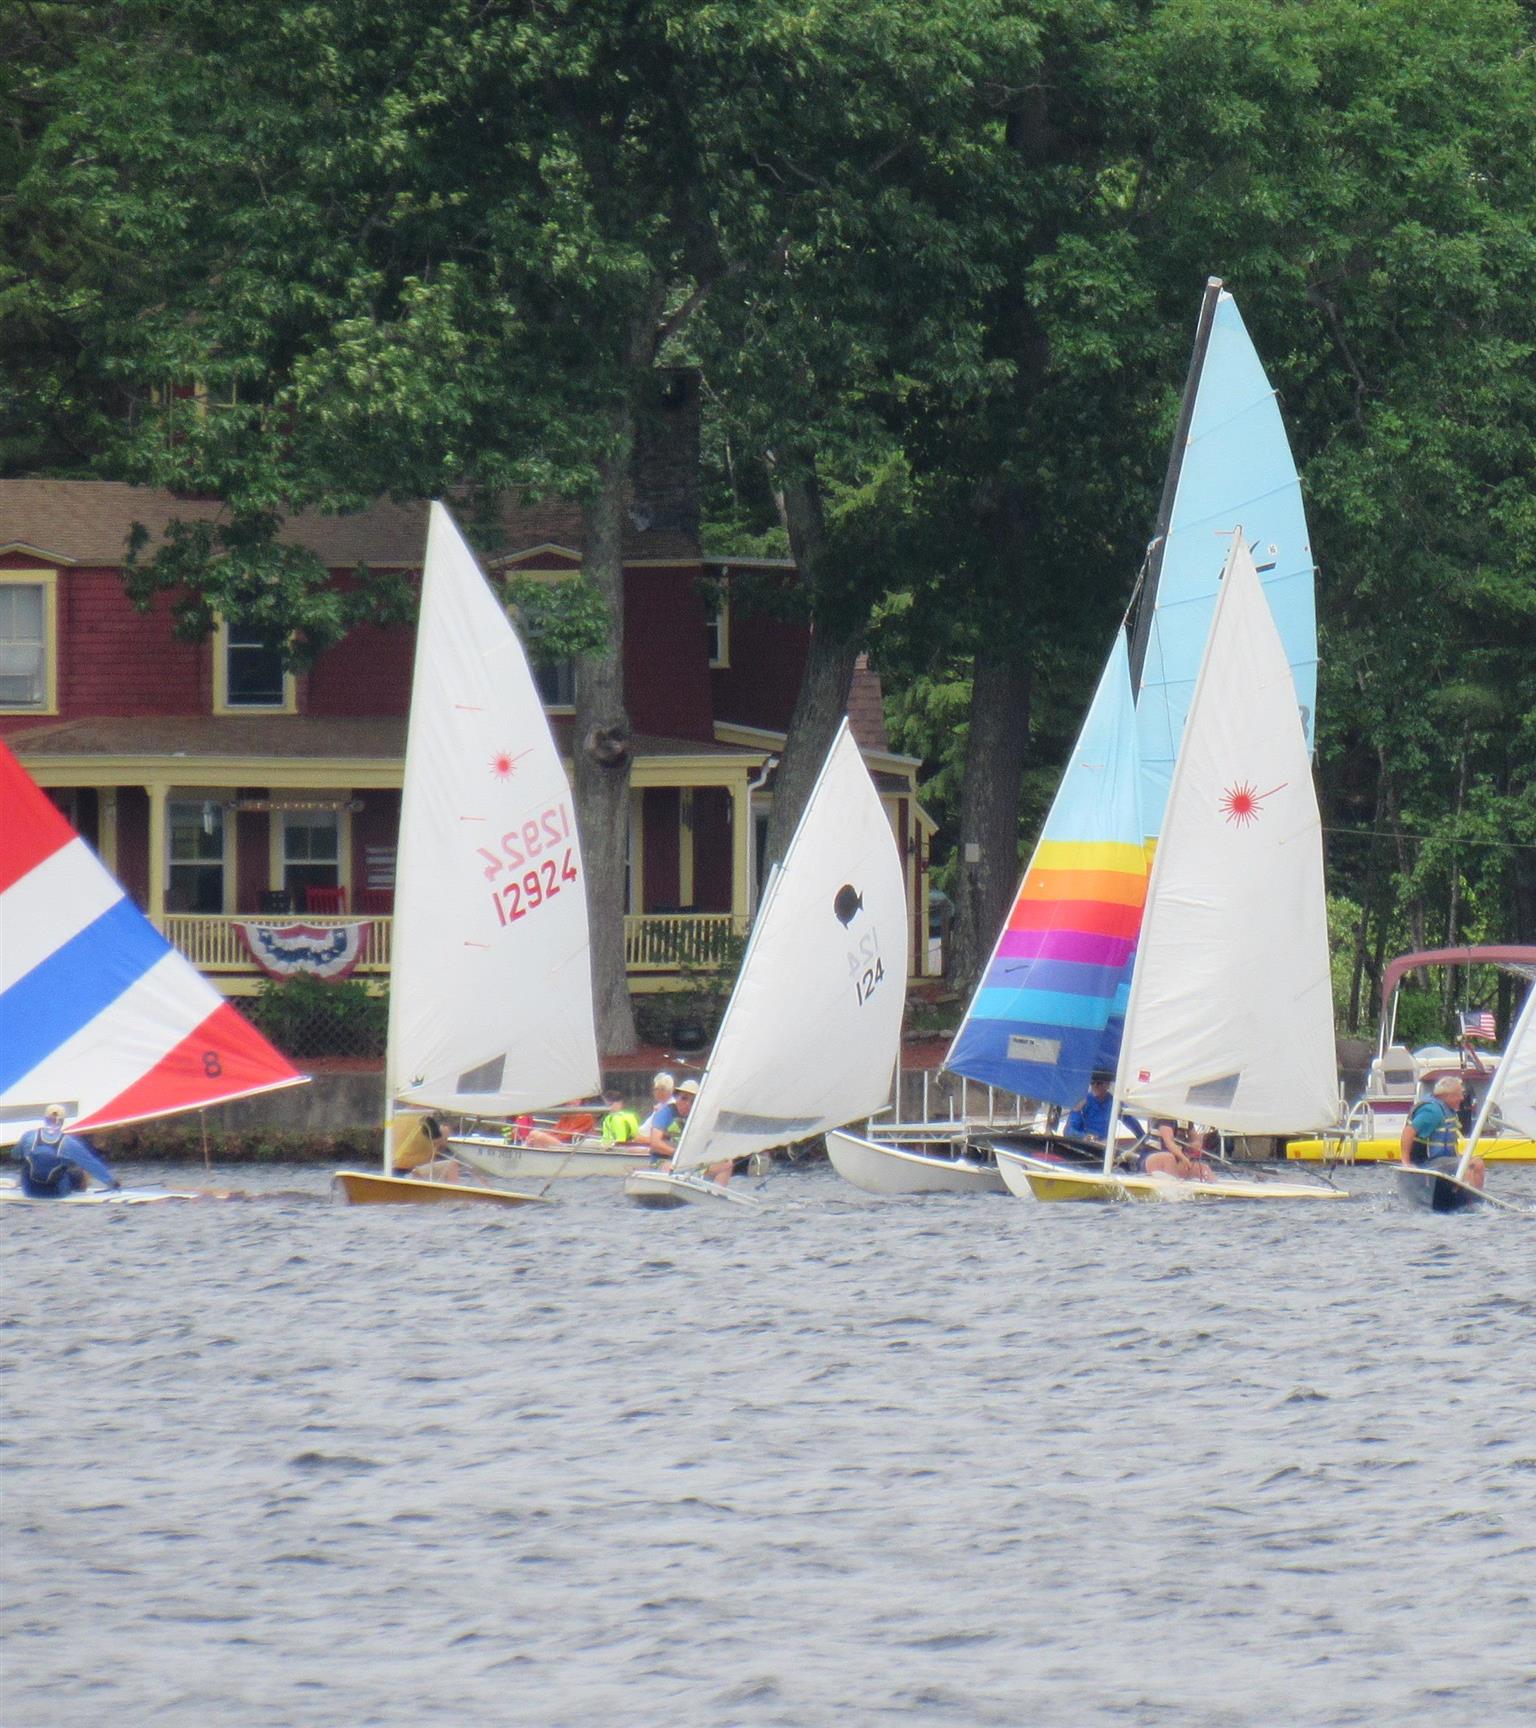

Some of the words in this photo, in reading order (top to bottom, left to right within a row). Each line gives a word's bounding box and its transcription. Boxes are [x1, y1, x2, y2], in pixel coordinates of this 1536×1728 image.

[492, 848, 577, 927] 12924
[857, 957, 885, 1006] 124
[202, 1051, 222, 1078] 8
